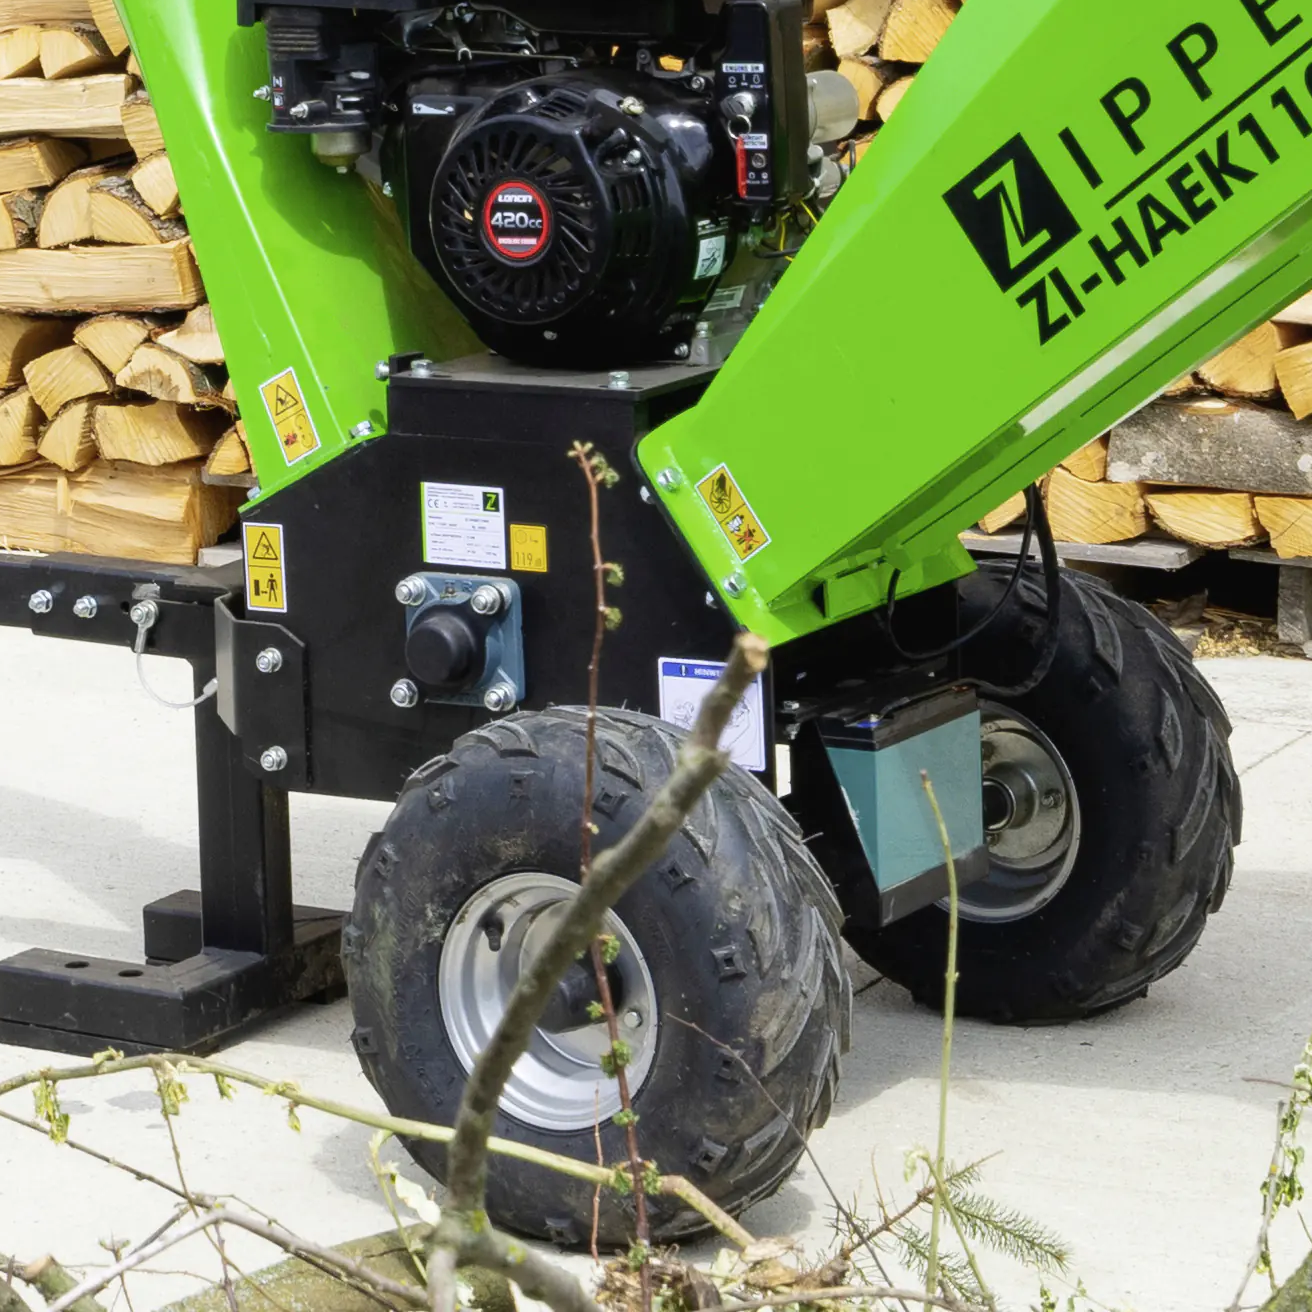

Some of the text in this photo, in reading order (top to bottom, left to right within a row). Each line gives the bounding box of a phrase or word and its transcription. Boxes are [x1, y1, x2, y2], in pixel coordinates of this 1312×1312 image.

[497, 194, 533, 203] LONCIN
[490, 211, 543, 229] 420cc
[515, 551, 533, 567] 119
